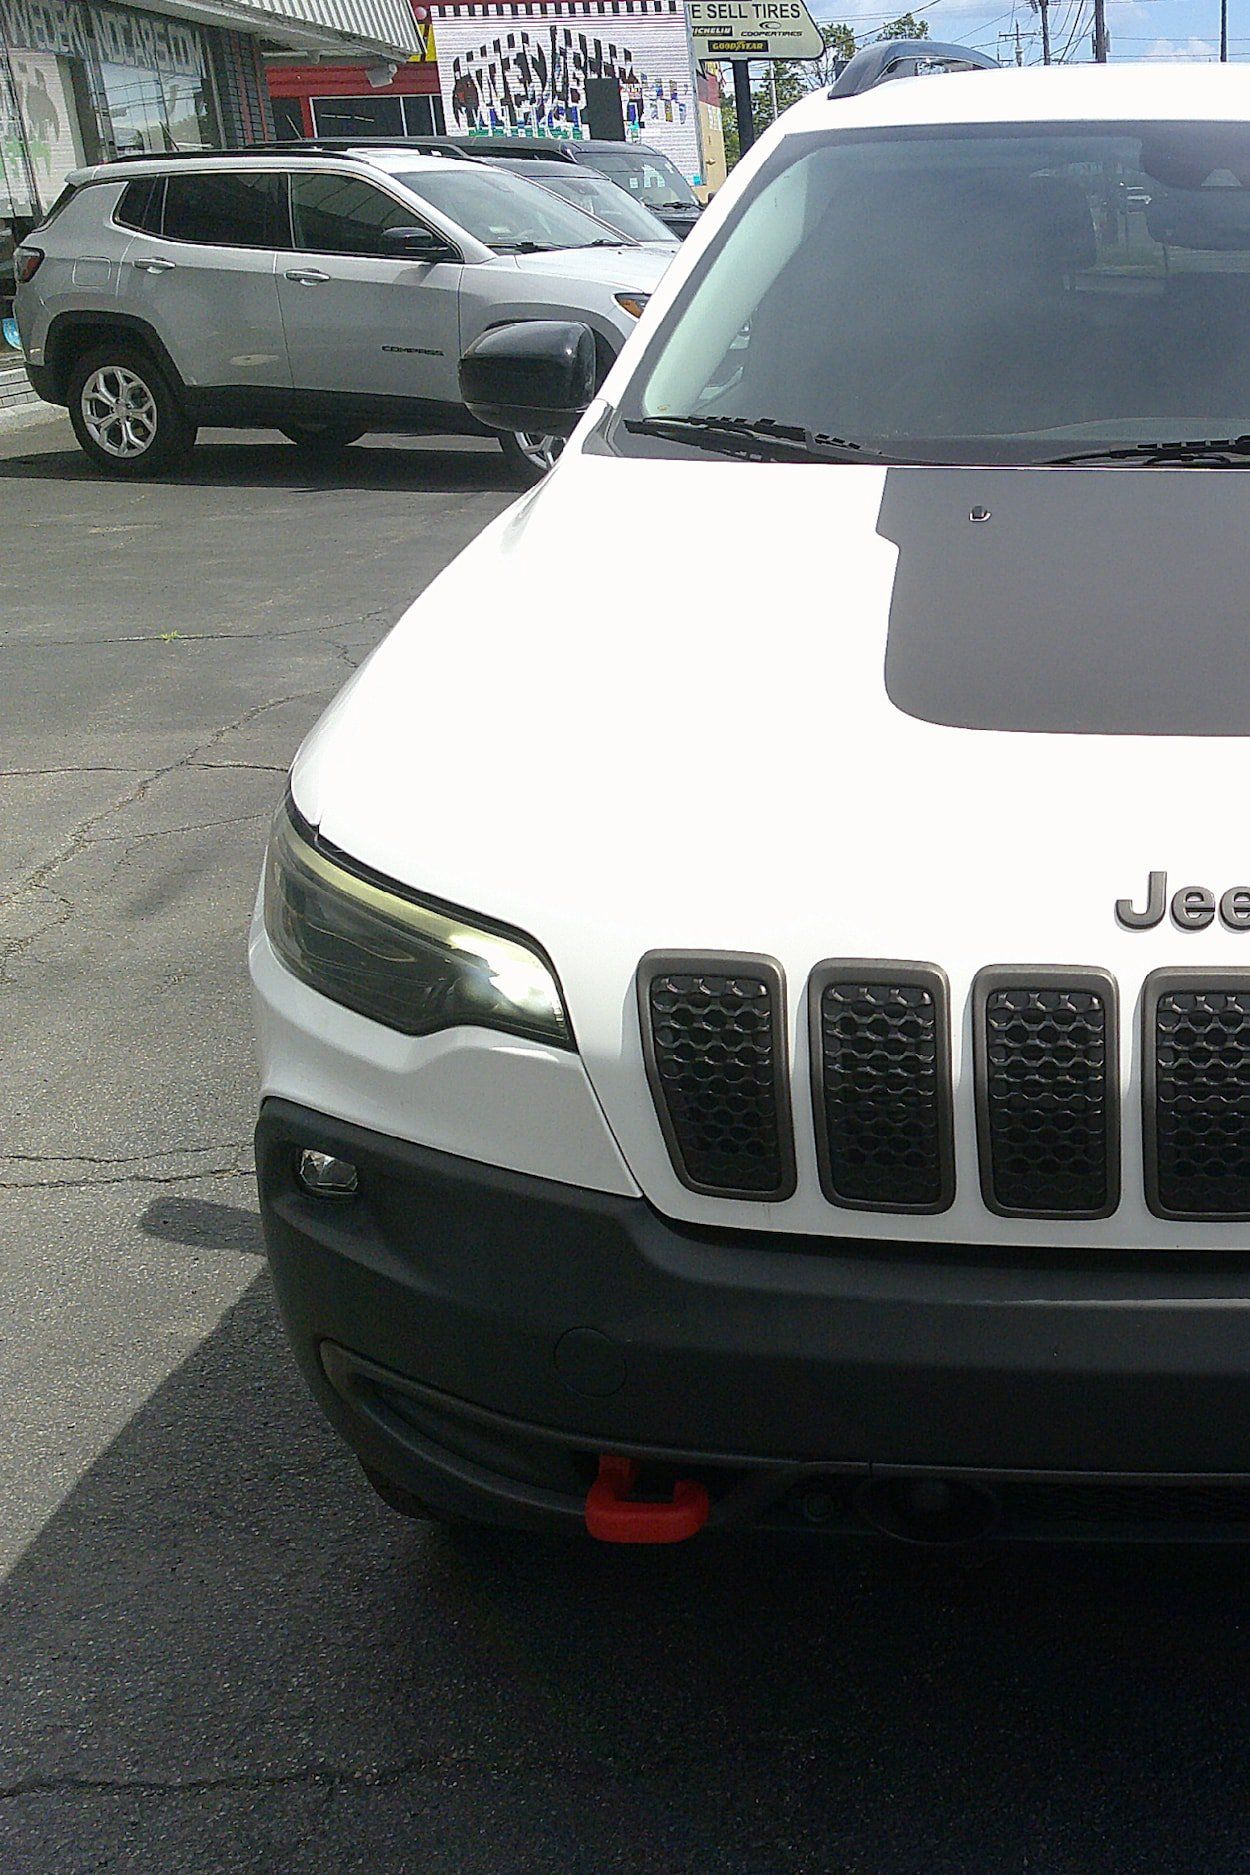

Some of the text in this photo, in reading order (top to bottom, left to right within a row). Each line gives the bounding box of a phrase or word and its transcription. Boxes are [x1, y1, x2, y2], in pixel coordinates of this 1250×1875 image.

[688, 4, 800, 19] E SELL TIRES
[712, 41, 764, 51] GOODYEAR
[381, 345, 444, 356] COMPASS
